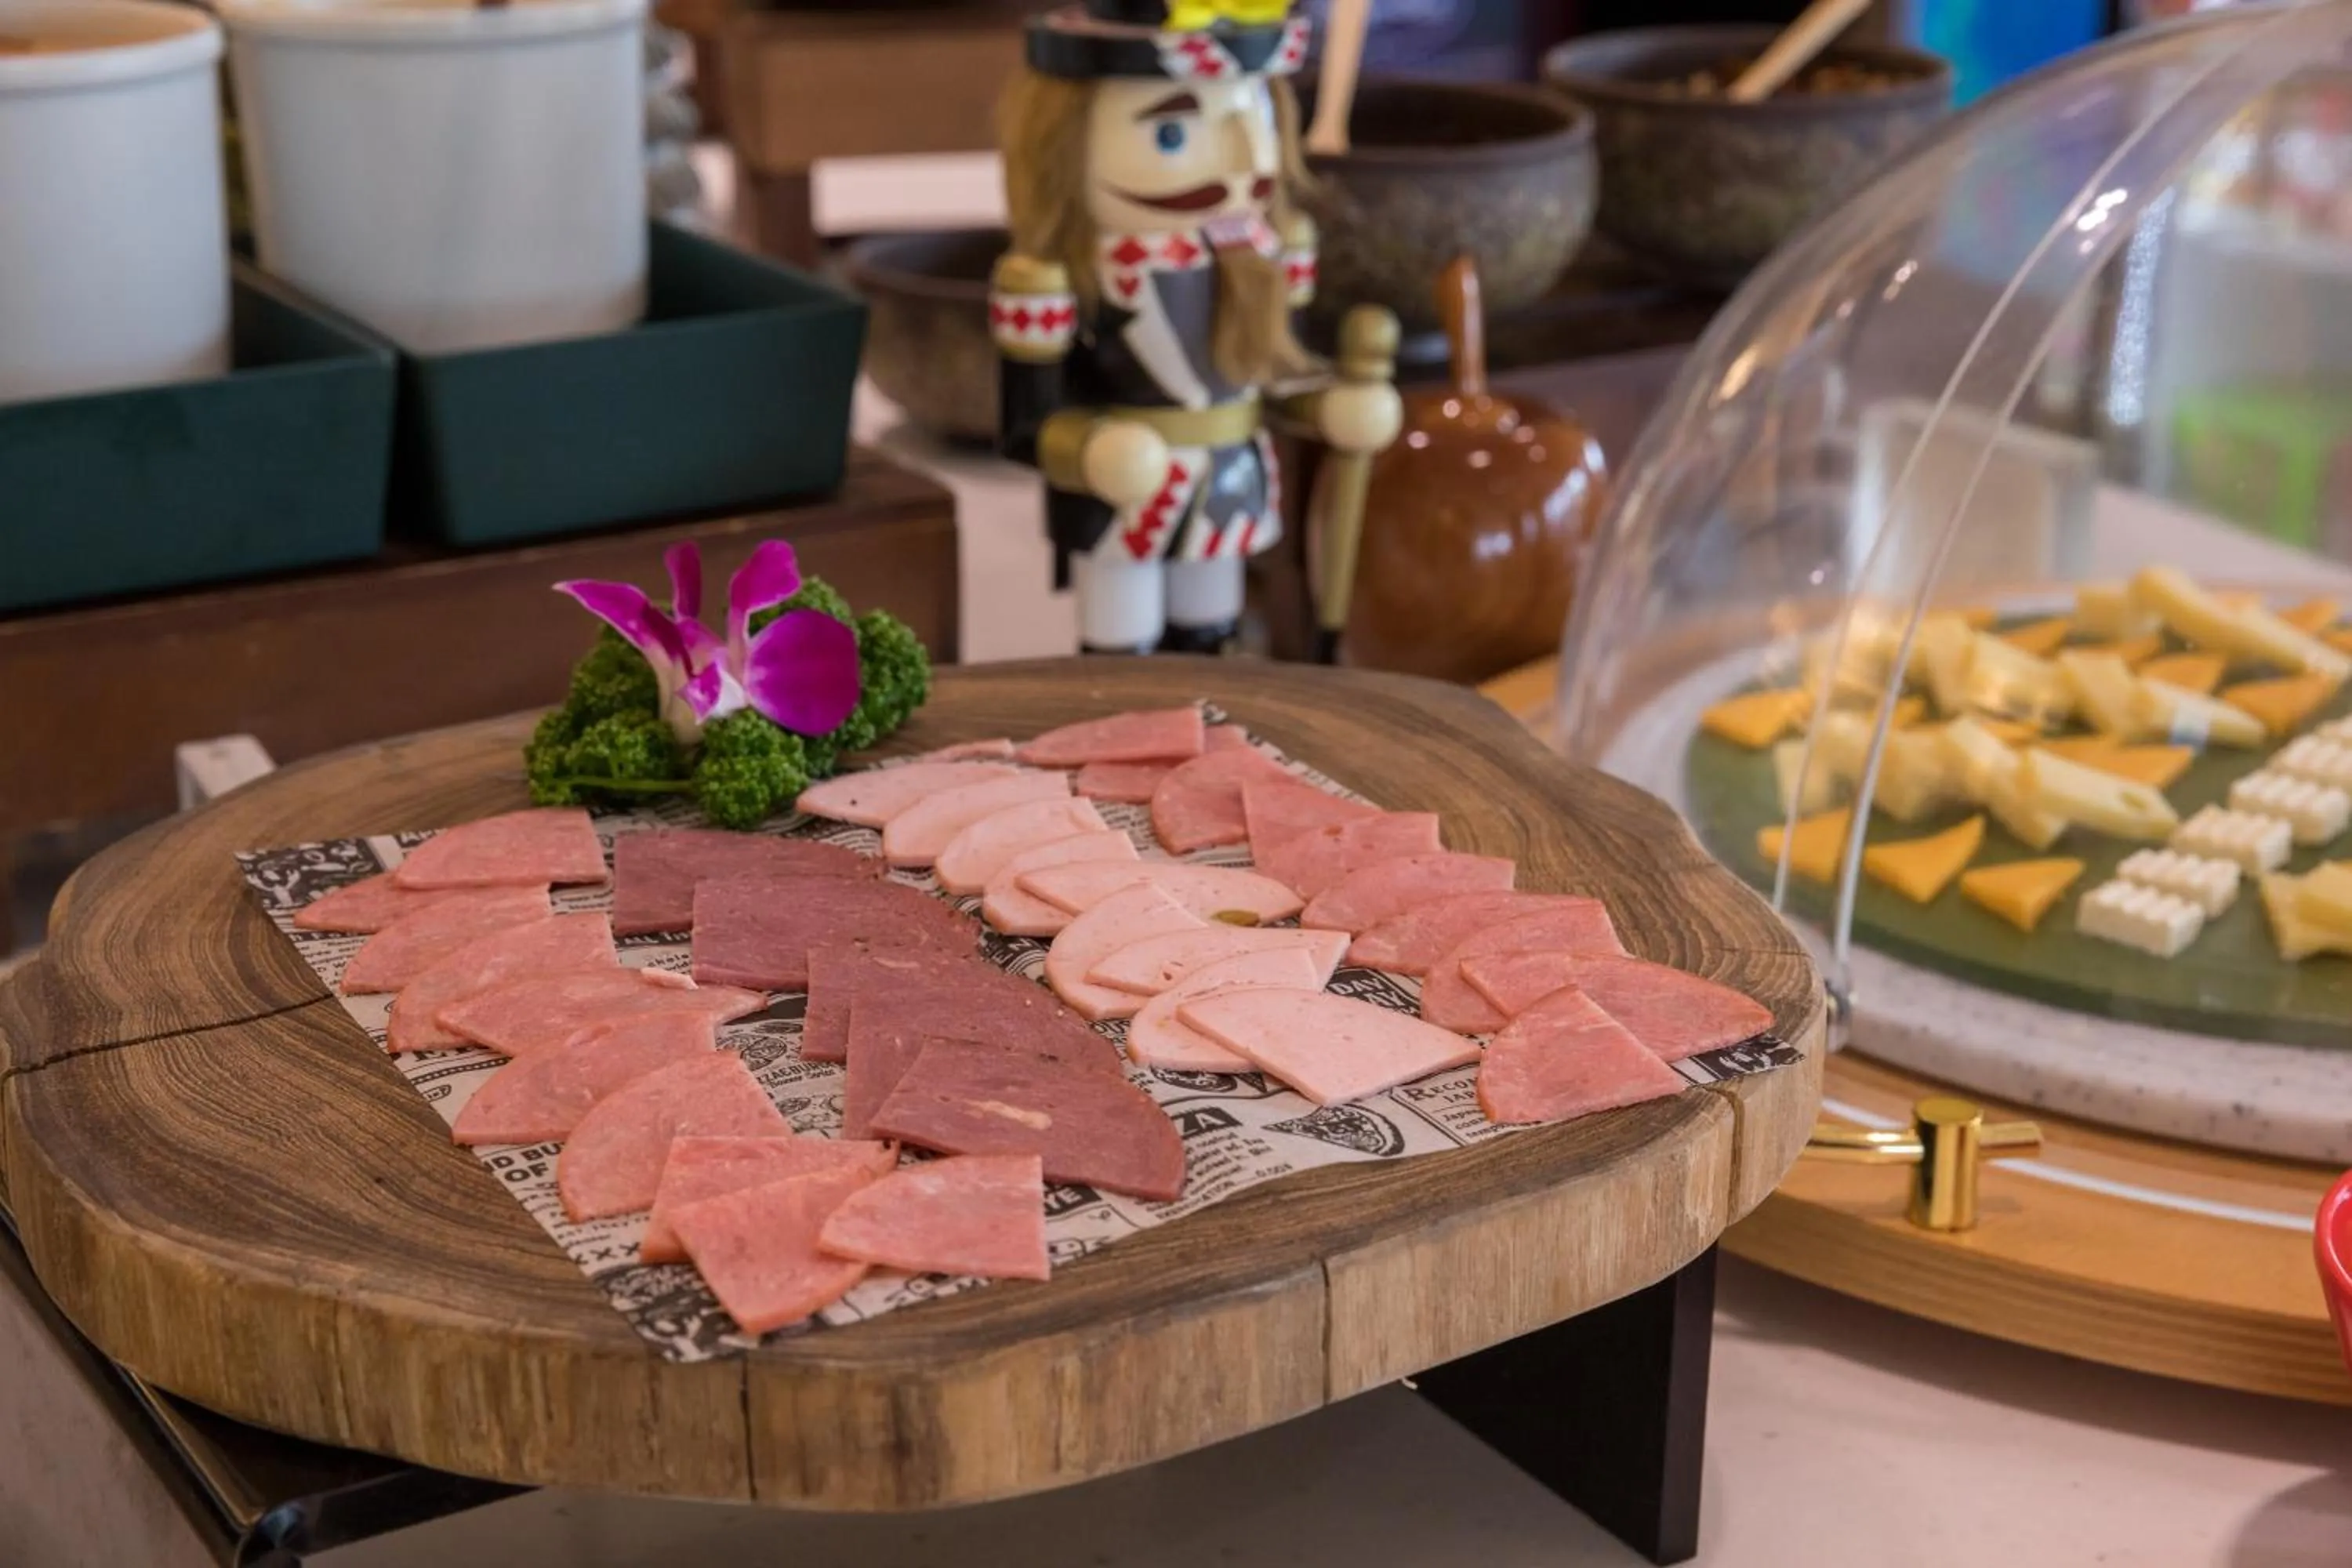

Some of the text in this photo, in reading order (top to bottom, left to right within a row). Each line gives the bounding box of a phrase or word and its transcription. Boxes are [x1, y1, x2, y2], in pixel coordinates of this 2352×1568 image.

[1328, 977, 1385, 995] DAY
[520, 1140, 565, 1161] BU
[503, 1161, 549, 1182] OF
